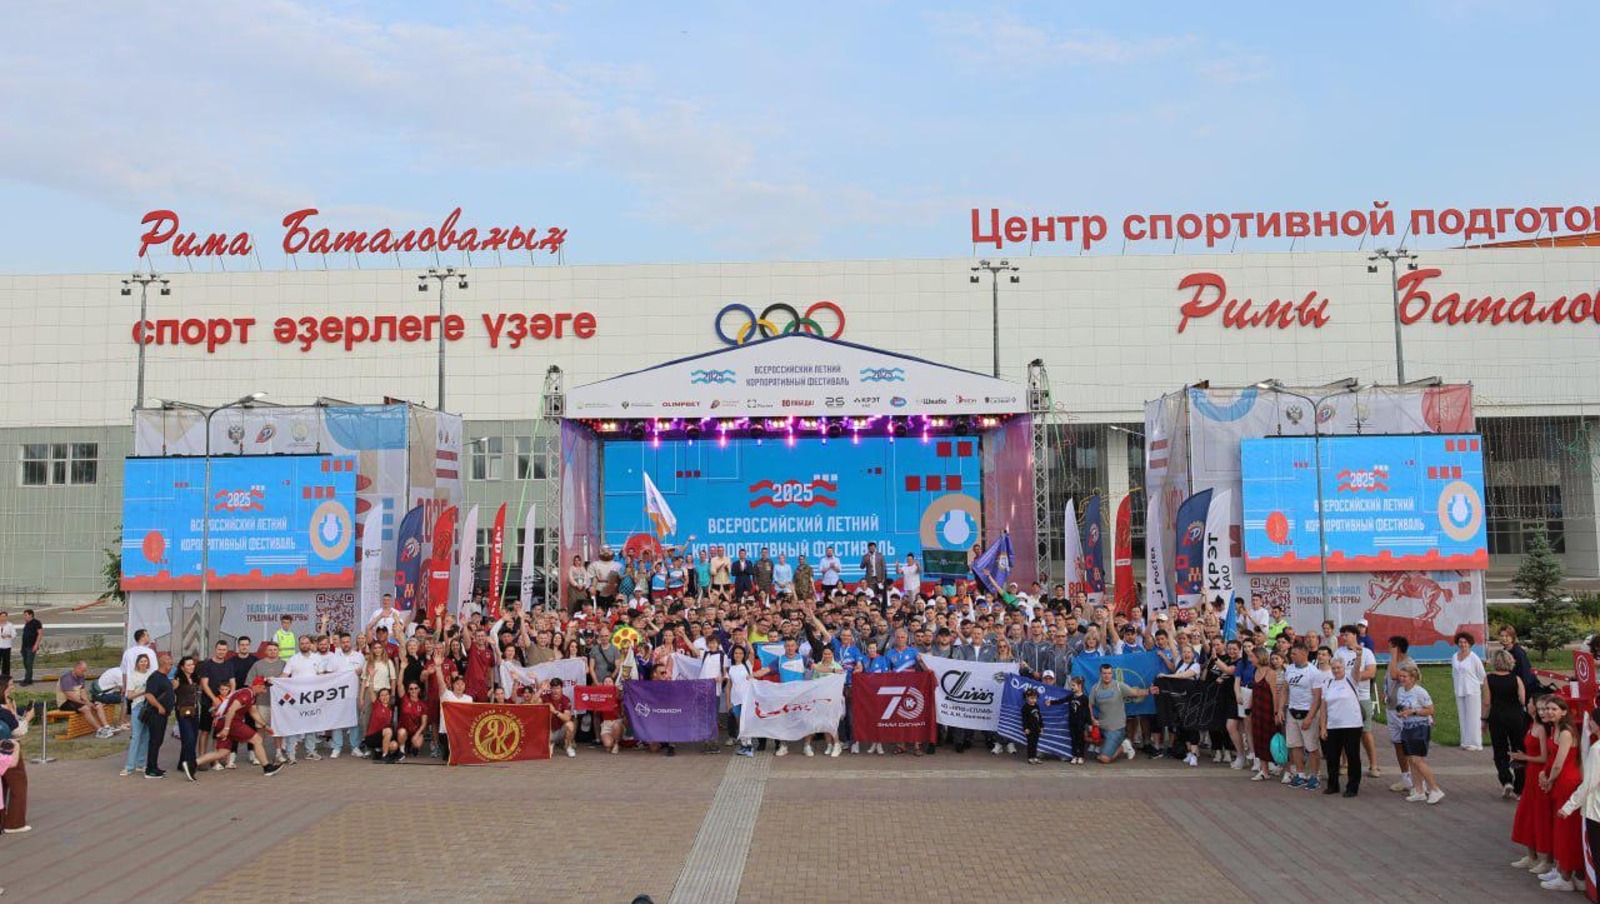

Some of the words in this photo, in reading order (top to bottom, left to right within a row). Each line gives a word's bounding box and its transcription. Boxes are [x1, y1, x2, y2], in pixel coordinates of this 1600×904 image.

[139, 209, 253, 257] Рима
[971, 209, 1107, 249] Центр
[1123, 202, 1395, 247] спортивной
[1411, 206, 1600, 239] подгото
[1178, 271, 1329, 332] Римы
[1397, 268, 1600, 325] Батало
[132, 318, 256, 353] спорт
[754, 365, 813, 375] ВСЕРОССИЙСКИЙ
[814, 364, 842, 374] ЛЕТНИЙ
[746, 377, 806, 387] КОРПОРАТИВНЫЙ
[807, 376, 850, 387] ФЕСТИВАЛЬ
[772, 483, 814, 502] 2025
[1383, 495, 1415, 512] ЛЕТНИЙ
[257, 515, 288, 531] ЛЕТНИЙ
[708, 516, 824, 534] ВСЕРОССИЙСКИЙ
[826, 513, 880, 533] ЛЕТНИЙ
[1375, 517, 1426, 532] ФЕСТИВАЛЬ
[248, 537, 296, 551] ФЕСТИВАЛЬ
[812, 540, 896, 558] ФЕСТИВЛЬ
[1207, 532, 1221, 590] КРЭТ
[1220, 565, 1232, 591] КАО
[300, 685, 349, 705] КРЭТ
